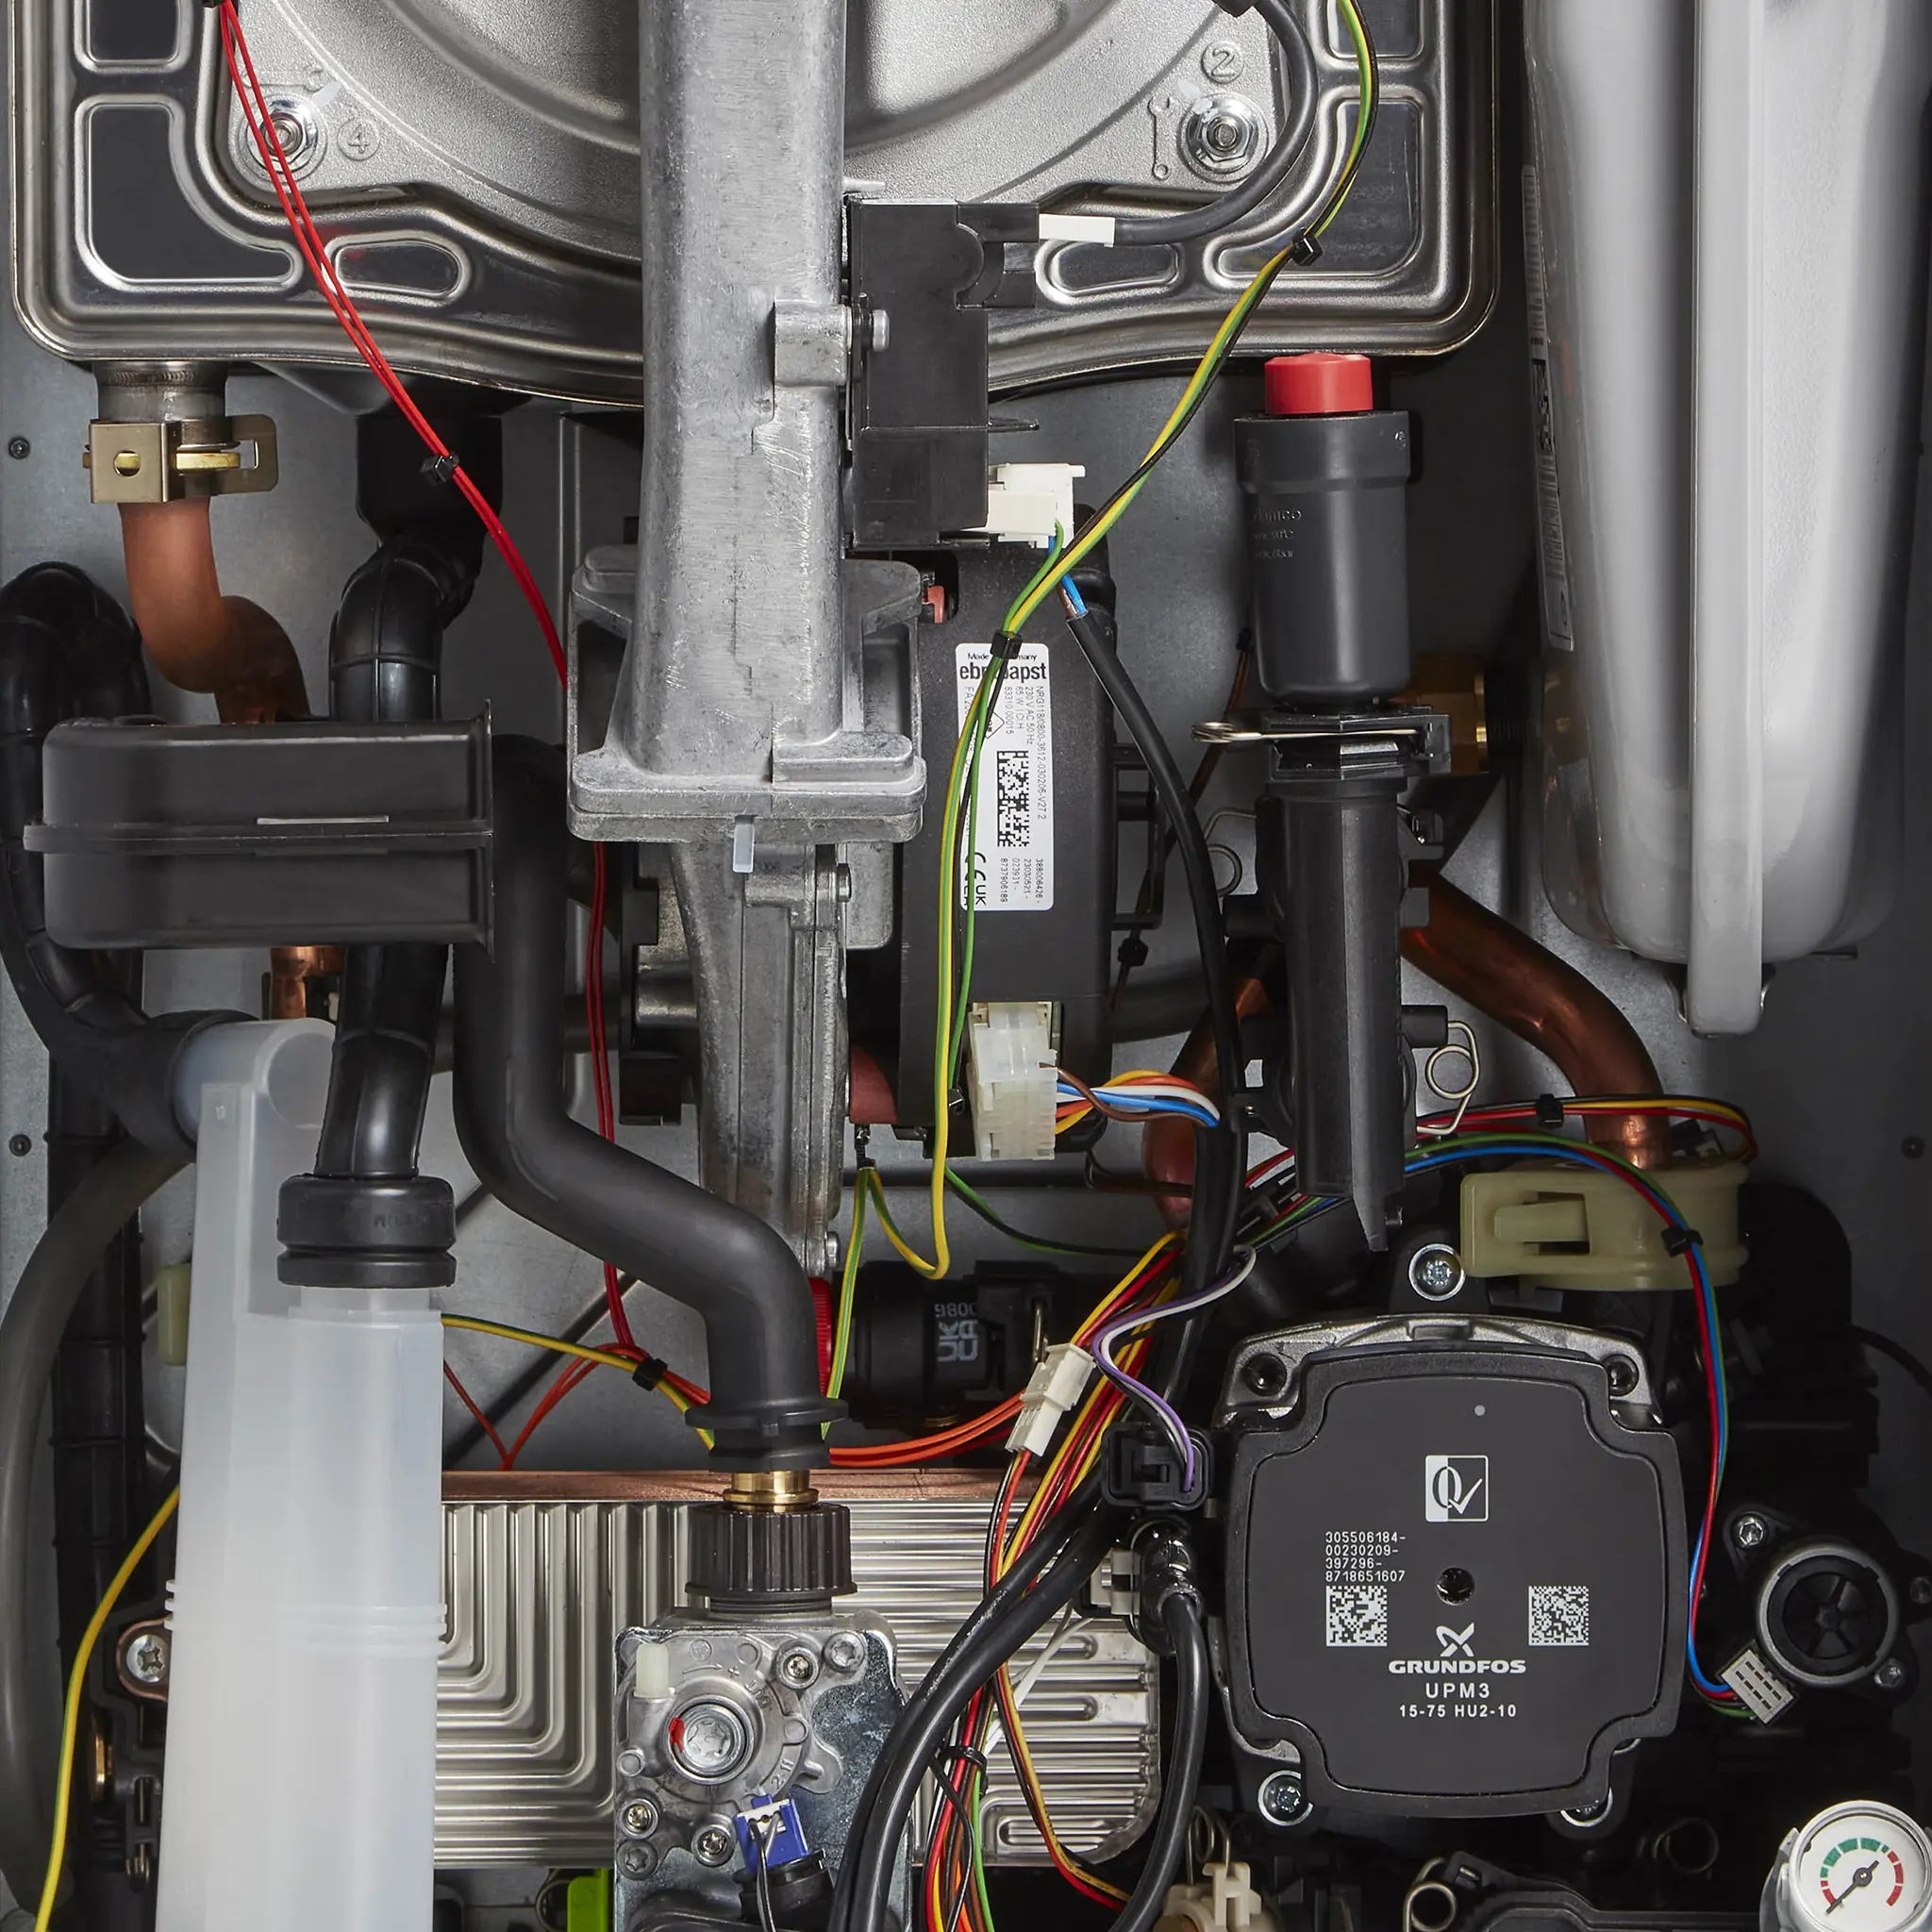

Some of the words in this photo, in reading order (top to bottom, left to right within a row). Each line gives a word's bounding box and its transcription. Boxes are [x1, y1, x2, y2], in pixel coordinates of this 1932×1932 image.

[1211, 46, 1236, 77] 2
[348, 124, 371, 154] 4
[1015, 686, 1024, 695] 65
[1024, 686, 1034, 700] 230
[1025, 709, 1035, 721] AC
[1026, 723, 1035, 732] 50
[1026, 734, 1035, 745] Hz
[1325, 1531, 1406, 1543] 305506184-
[1325, 1544, 1399, 1557] 00230209-
[1325, 1557, 1382, 1570] 397296-
[1325, 1570, 1406, 1582] 8718651607
[1388, 1659, 1526, 1674] GRUNDFOS
[1425, 1682, 1491, 1699] UPM3
[1399, 1704, 1446, 1718] 15-75
[1454, 1704, 1517, 1718] HU2-10
